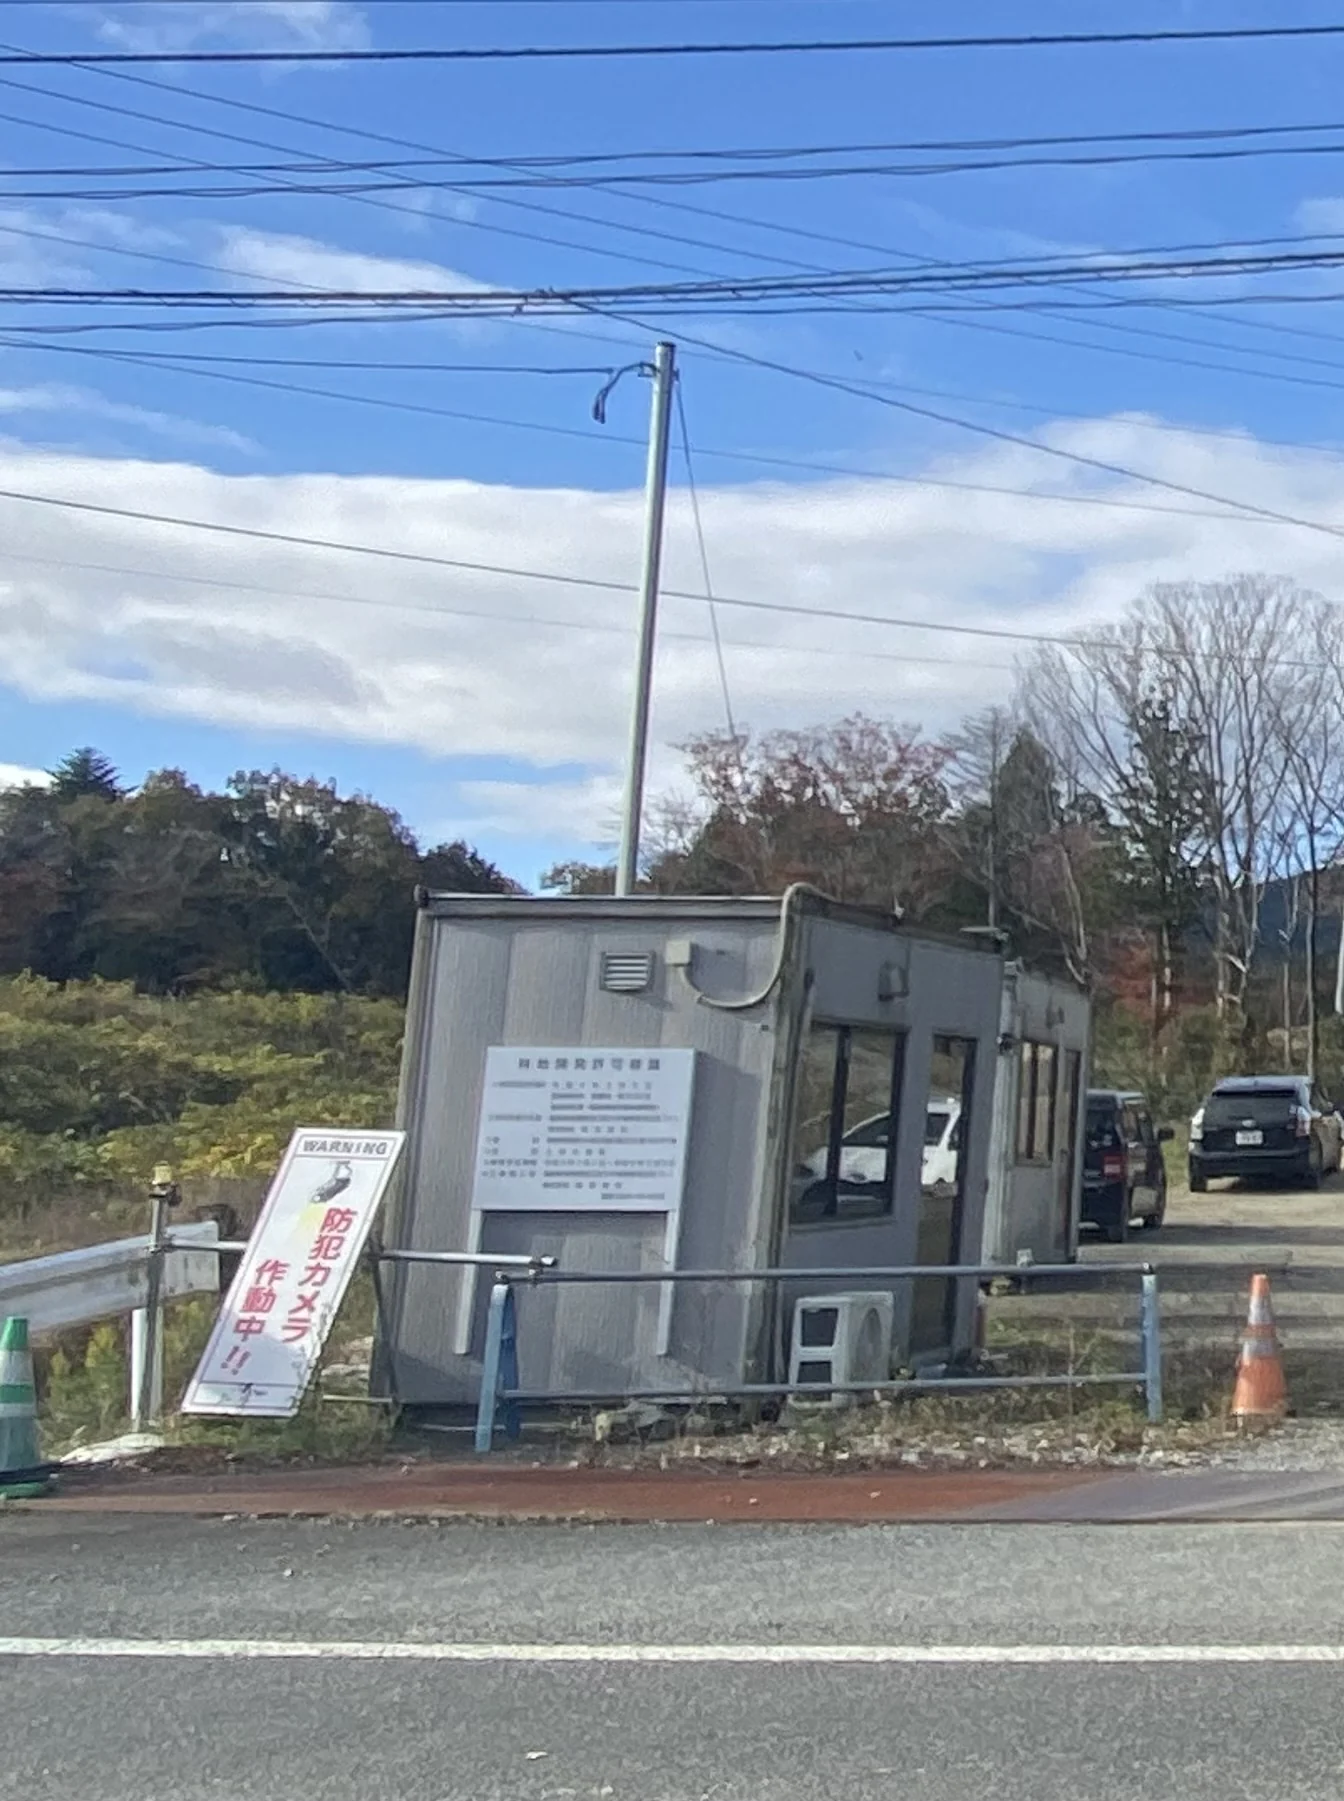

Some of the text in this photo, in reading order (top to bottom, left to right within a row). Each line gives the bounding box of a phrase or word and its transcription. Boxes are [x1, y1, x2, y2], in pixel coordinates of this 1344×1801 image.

[303, 1139, 388, 1155] WARNING
[281, 1207, 358, 1344] 防犯カメラ
